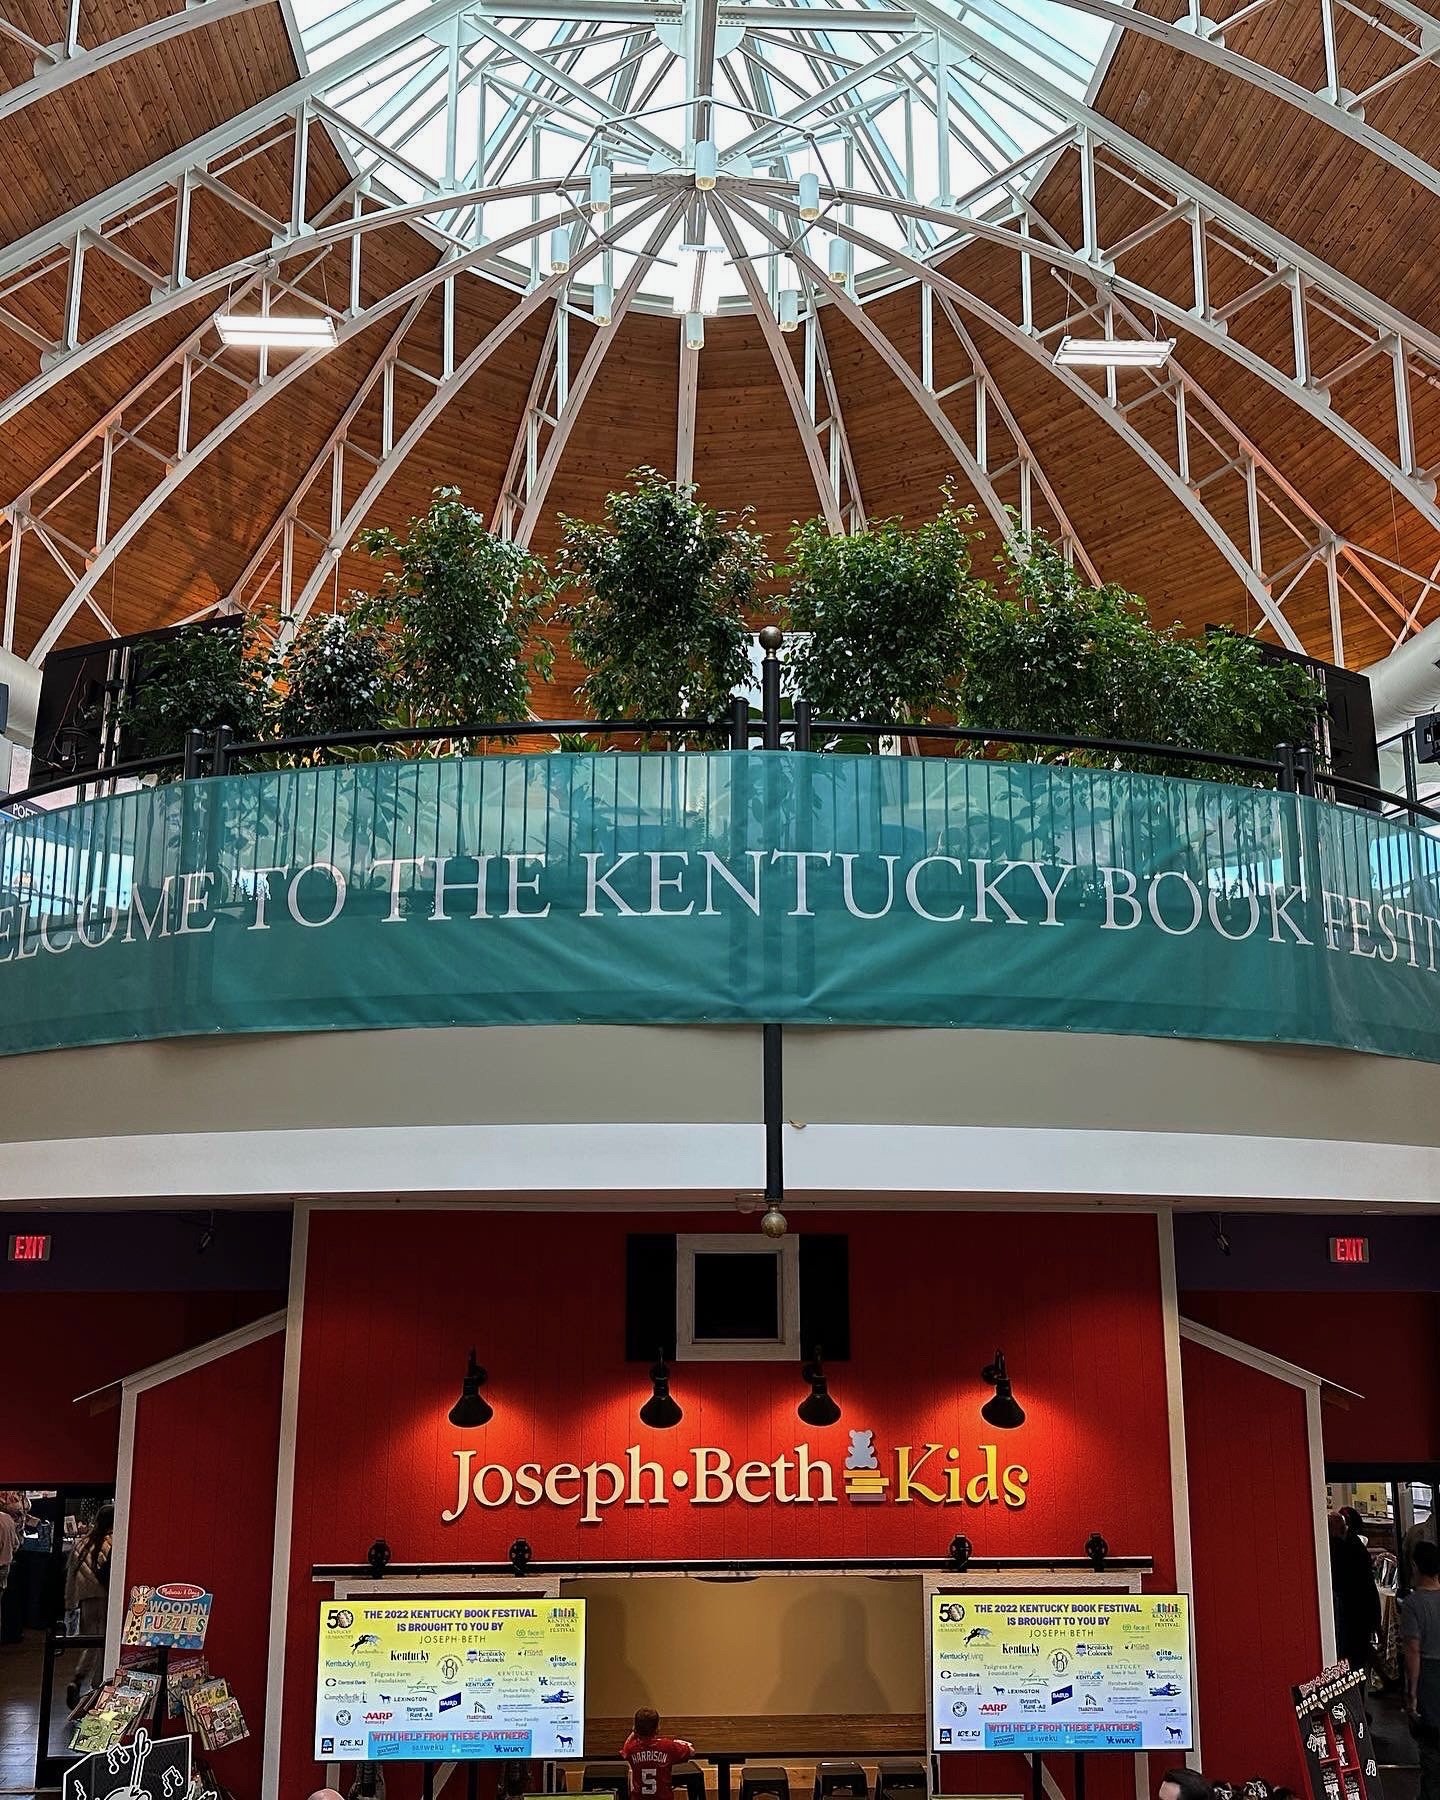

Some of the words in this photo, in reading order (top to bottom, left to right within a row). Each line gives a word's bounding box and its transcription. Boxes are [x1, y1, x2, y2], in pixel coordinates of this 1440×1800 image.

[0, 871, 216, 962] ELCOME
[233, 859, 347, 930] TO
[369, 853, 551, 922] THE
[579, 848, 1076, 926] KENTUCKY
[1096, 867, 1314, 946] BOOK
[1322, 890, 1440, 973] FESTI
[15, 1236, 46, 1259] EXIT
[1336, 1238, 1364, 1261] EXIT
[894, 1443, 1030, 1508] Kids
[148, 1600, 208, 1616] WOODEN
[363, 1610, 383, 1619] THE
[385, 1610, 409, 1619] 2022
[411, 1609, 462, 1619] KENTUCKY
[464, 1609, 490, 1618] BOOK
[492, 1609, 538, 1618] FESTIVAL
[938, 1603, 965, 1622] 50
[974, 1604, 993, 1613] THE
[994, 1604, 1018, 1613] 2022
[1019, 1604, 1069, 1613] KENTUCKY
[1071, 1604, 1096, 1613] BOOK
[1098, 1604, 1142, 1613] FESTIVAL
[144, 1614, 206, 1633] PUZZLES
[327, 1609, 354, 1629] 50
[1007, 1617, 1016, 1625] IS
[1019, 1617, 1062, 1625] BROUGHT
[1063, 1617, 1075, 1625] TO
[1077, 1617, 1096, 1625] YOU
[1097, 1617, 1110, 1625] BY
[397, 1623, 407, 1632] IS
[408, 1623, 454, 1632] BROUGHT
[456, 1622, 468, 1631] TO
[469, 1622, 490, 1631] YOU
[491, 1622, 504, 1631] BY
[390, 1650, 430, 1661] Kentucky
[1002, 1643, 1040, 1655] Kentucky
[981, 1703, 1008, 1712] AARP
[365, 1712, 393, 1720] AARP
[988, 1724, 1012, 1733] WITH
[1013, 1724, 1036, 1733] HELP
[1039, 1724, 1061, 1733] FROM
[1064, 1723, 1093, 1732] THESE
[1094, 1723, 1140, 1732] PARTNERS
[372, 1732, 397, 1741] WITH
[399, 1732, 421, 1741] HELP
[424, 1732, 448, 1741] FROM
[451, 1731, 480, 1741] THESE
[481, 1731, 529, 1740] PARTNERS
[631, 1750, 668, 1765] HARRISON
[641, 1768, 657, 1795] 5
